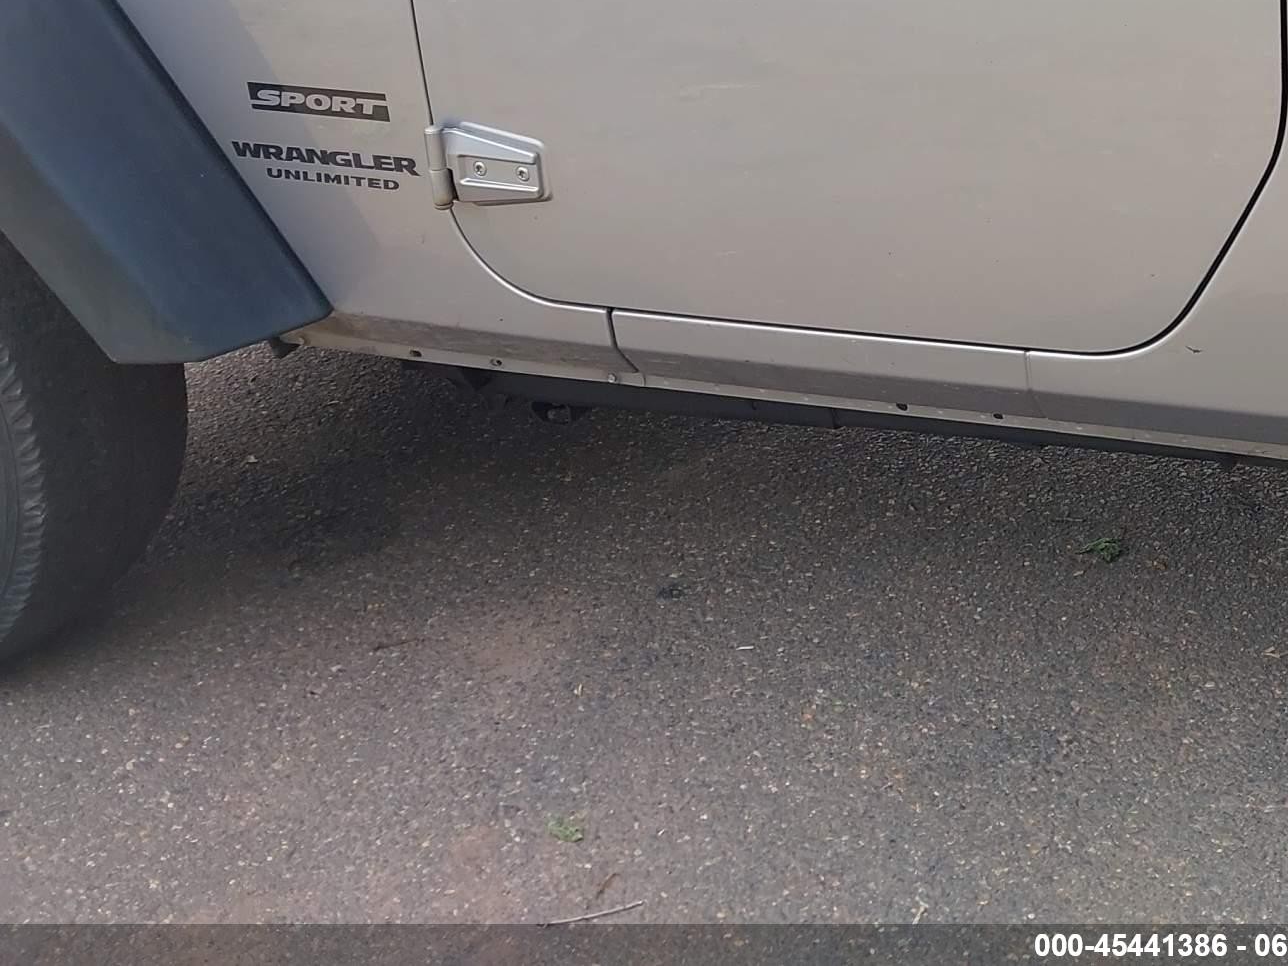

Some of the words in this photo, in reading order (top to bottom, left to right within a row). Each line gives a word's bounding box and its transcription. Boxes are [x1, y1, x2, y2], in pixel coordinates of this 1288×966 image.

[250, 89, 388, 116] SPORT
[231, 140, 421, 177] WRANGLER
[266, 167, 400, 191] UNLIMITED
